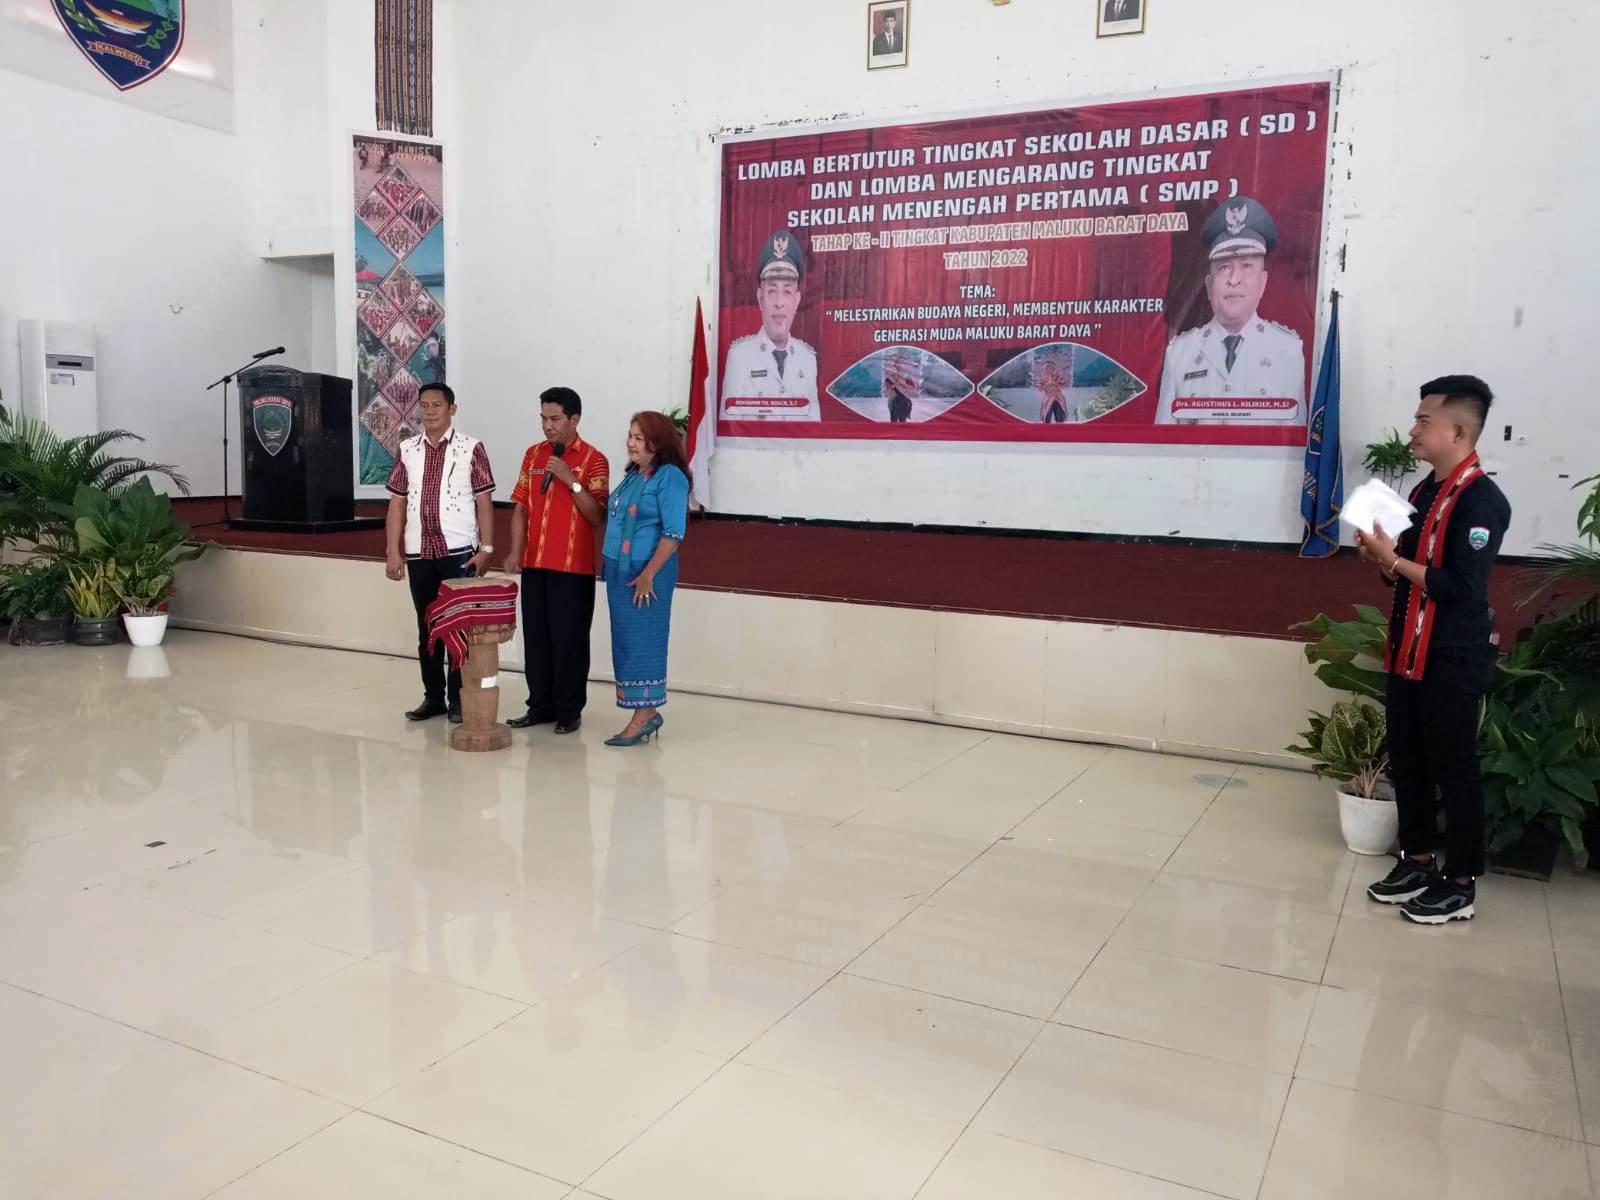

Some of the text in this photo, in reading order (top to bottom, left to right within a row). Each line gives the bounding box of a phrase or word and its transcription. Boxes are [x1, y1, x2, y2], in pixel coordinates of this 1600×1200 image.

[738, 159, 806, 180] LOMBA
[813, 149, 915, 174] BERTUTUR
[922, 138, 1017, 164] TINGKAT
[1024, 127, 1131, 155] SEKOLAH
[1141, 119, 1228, 145] DASAR
[1259, 112, 1295, 135] SD
[811, 150, 1212, 200] DAN LOMBA MENGARANG TINGKAT
[787, 204, 875, 227] SEKOLAH
[882, 194, 1007, 221] MENENGAH
[1015, 186, 1129, 212] PERTAMA
[1158, 180, 1219, 202] SMP
[811, 234, 852, 252] TAHAP
[892, 228, 949, 247] TINGKAT
[950, 221, 1031, 244] KABUPATEN
[1033, 217, 1093, 239] MALUKU
[1095, 215, 1146, 236] BARAT
[1147, 212, 1189, 232] DAYA
[943, 248, 1028, 270] TAHUN 2022
[960, 285, 996, 299] TEMA:
[918, 305, 961, 319] BUDAYA
[964, 303, 1010, 318] NEGERI,
[1012, 301, 1091, 316] MEMBENTUK
[1094, 298, 1164, 313] KARAKTER
[874, 328, 927, 342] GENERASI
[929, 327, 963, 340] MUDA
[966, 326, 1014, 340] MALUKU
[1017, 324, 1056, 339] BARAT
